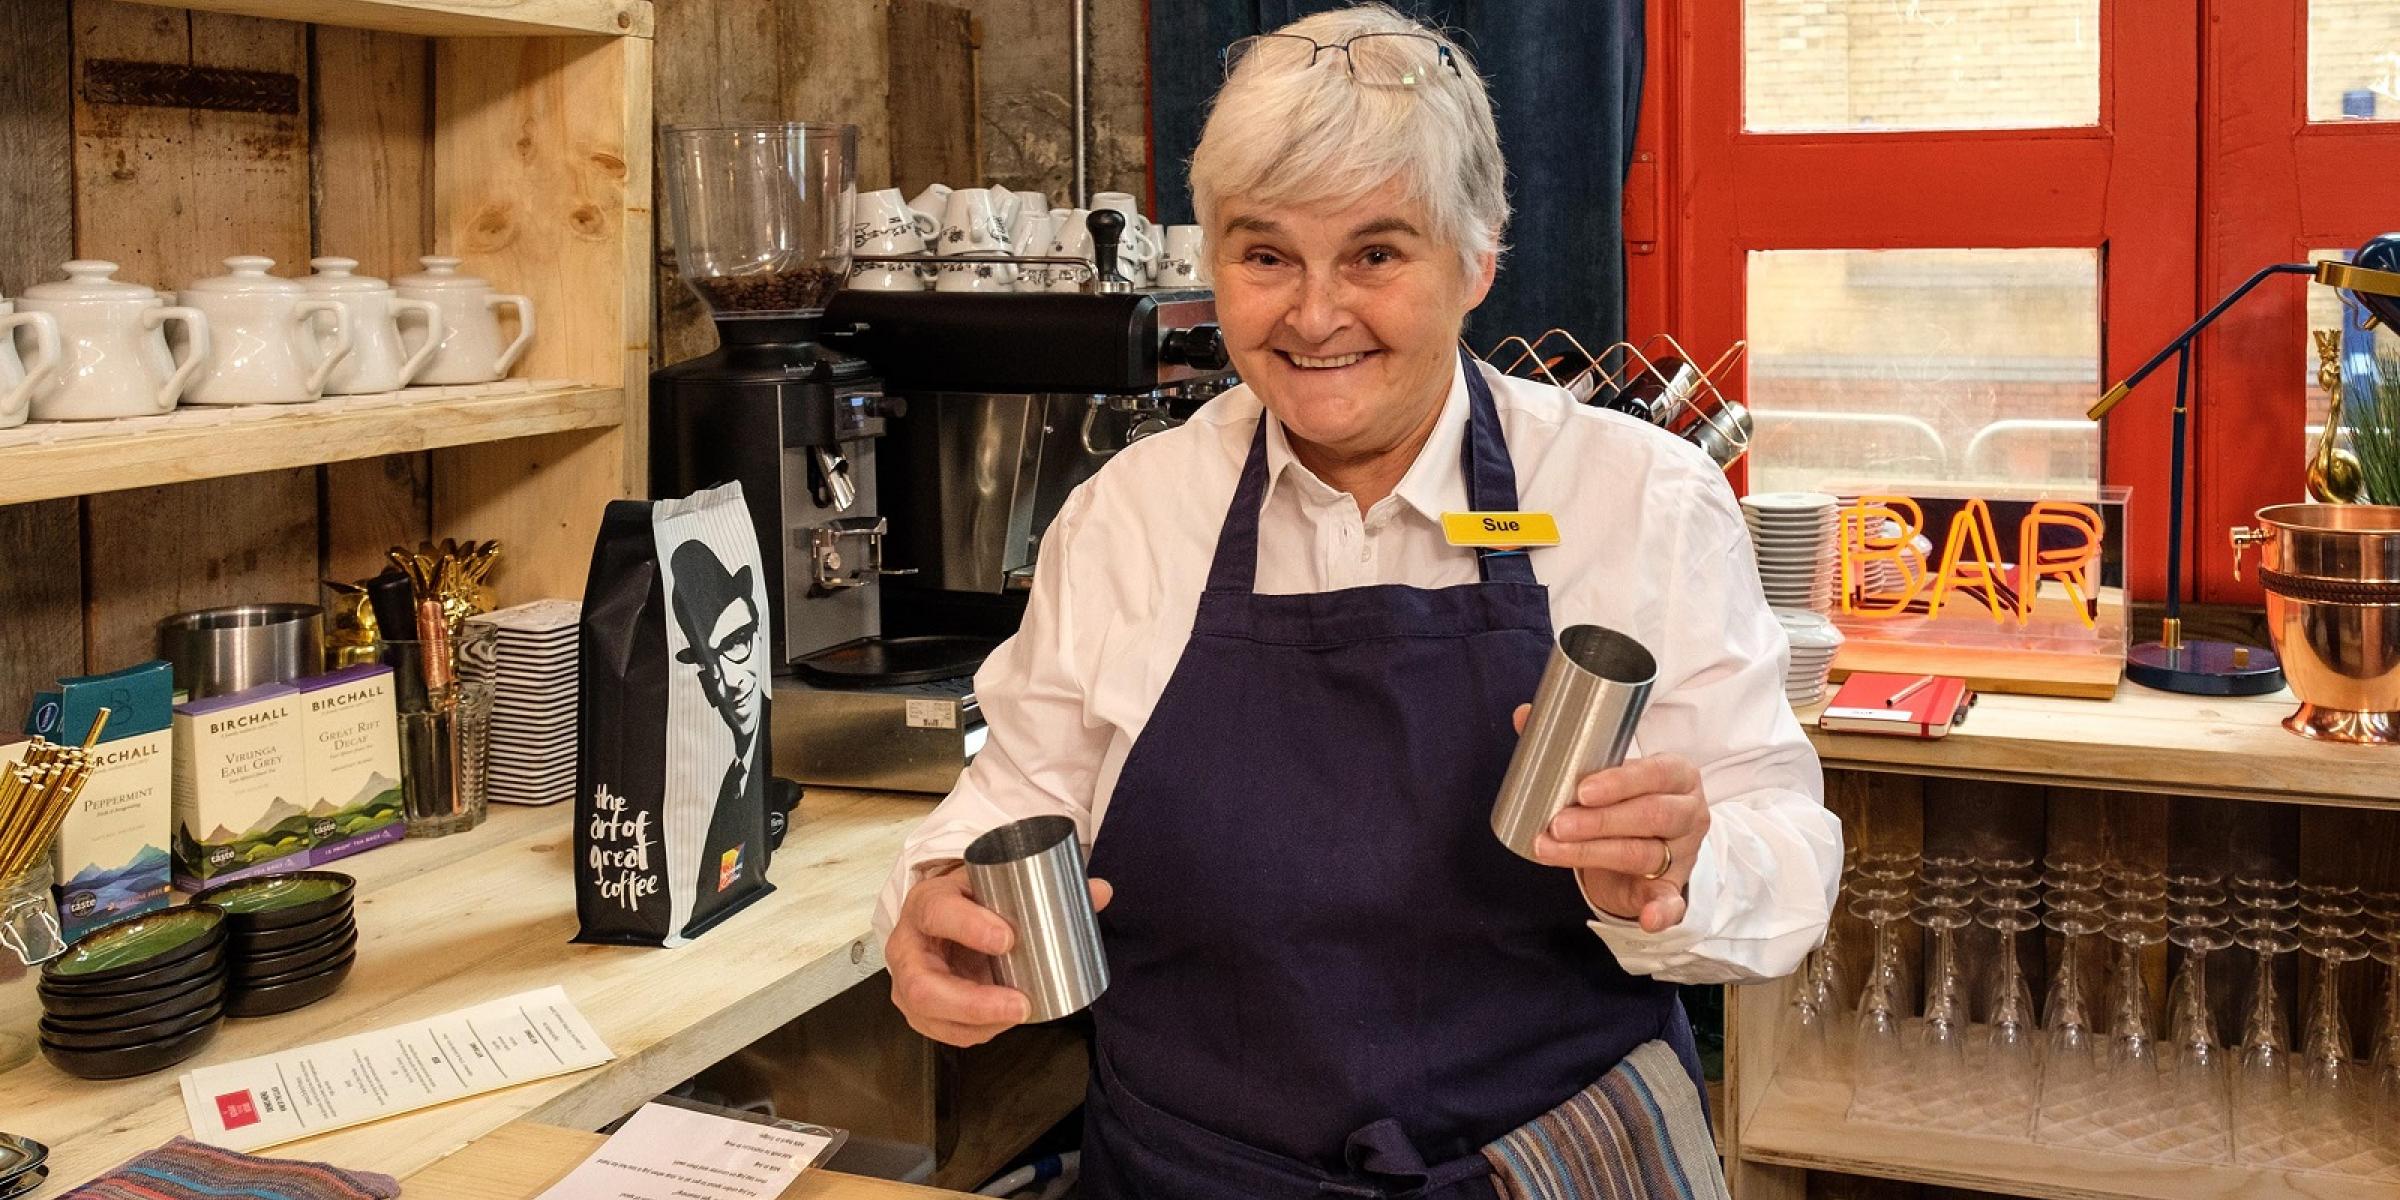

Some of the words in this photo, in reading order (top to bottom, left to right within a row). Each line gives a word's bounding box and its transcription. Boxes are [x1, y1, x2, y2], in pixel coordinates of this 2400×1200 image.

[1482, 517, 1521, 532] Sue
[1840, 495, 2104, 629] BAR
[311, 686, 384, 712] BIRCHALL
[210, 707, 289, 734] BIRCHALL
[94, 743, 160, 768] RCHALL
[594, 783, 629, 812] the
[590, 809, 623, 842] art
[621, 810, 654, 841] of
[590, 834, 658, 886] great
[601, 869, 660, 913] coffee
[71, 898, 97, 913] taste
